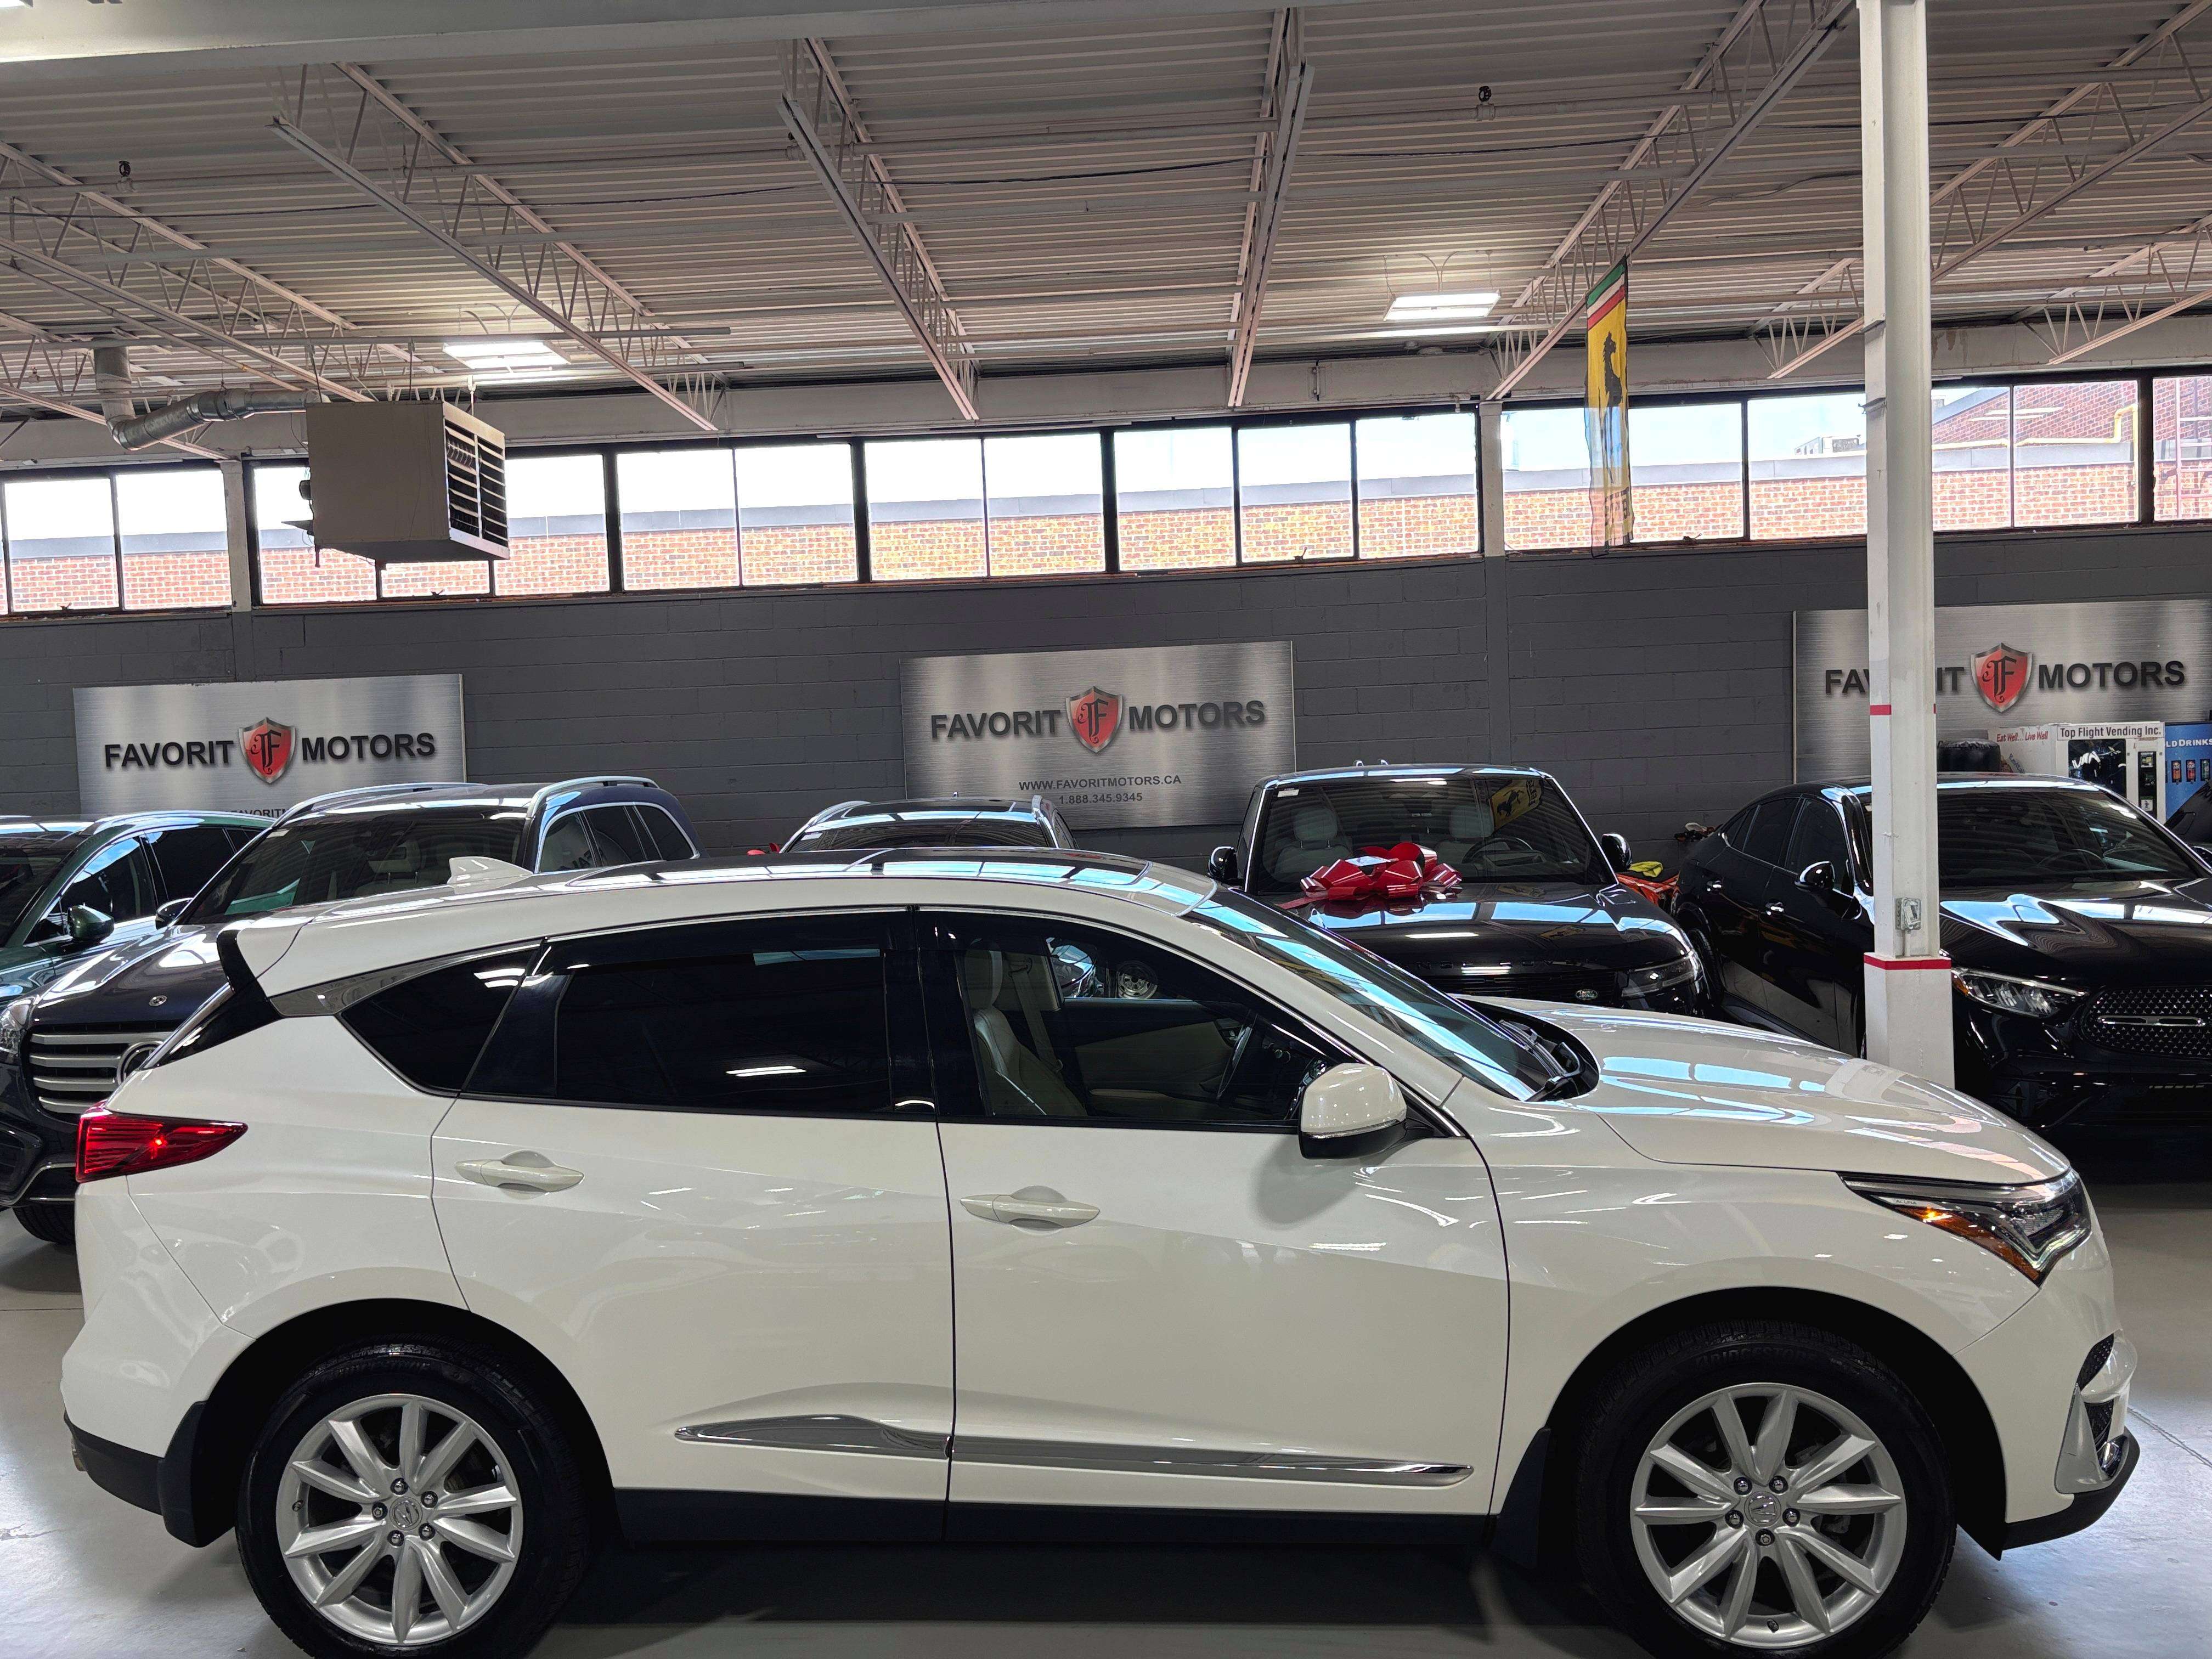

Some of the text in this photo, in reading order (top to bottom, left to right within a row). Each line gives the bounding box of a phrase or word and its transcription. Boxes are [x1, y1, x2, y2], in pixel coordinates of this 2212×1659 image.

[1825, 667, 1965, 694] FAIT
[2039, 661, 2185, 689] MOTORS
[931, 710, 1061, 738] FAVORIT
[1129, 701, 1265, 730] MOTORS
[1997, 733, 2006, 742] Eat
[2025, 732, 2035, 741] Live
[2037, 731, 2048, 740] Well
[2060, 726, 2162, 738] Top Flight Vending Inc.
[105, 740, 234, 767] FAVORIT
[302, 733, 436, 761] MOTORS
[1019, 775, 1181, 791] WWW.FAVORITMOTORS.CA
[1059, 793, 1143, 804] 1.888.345.9345
